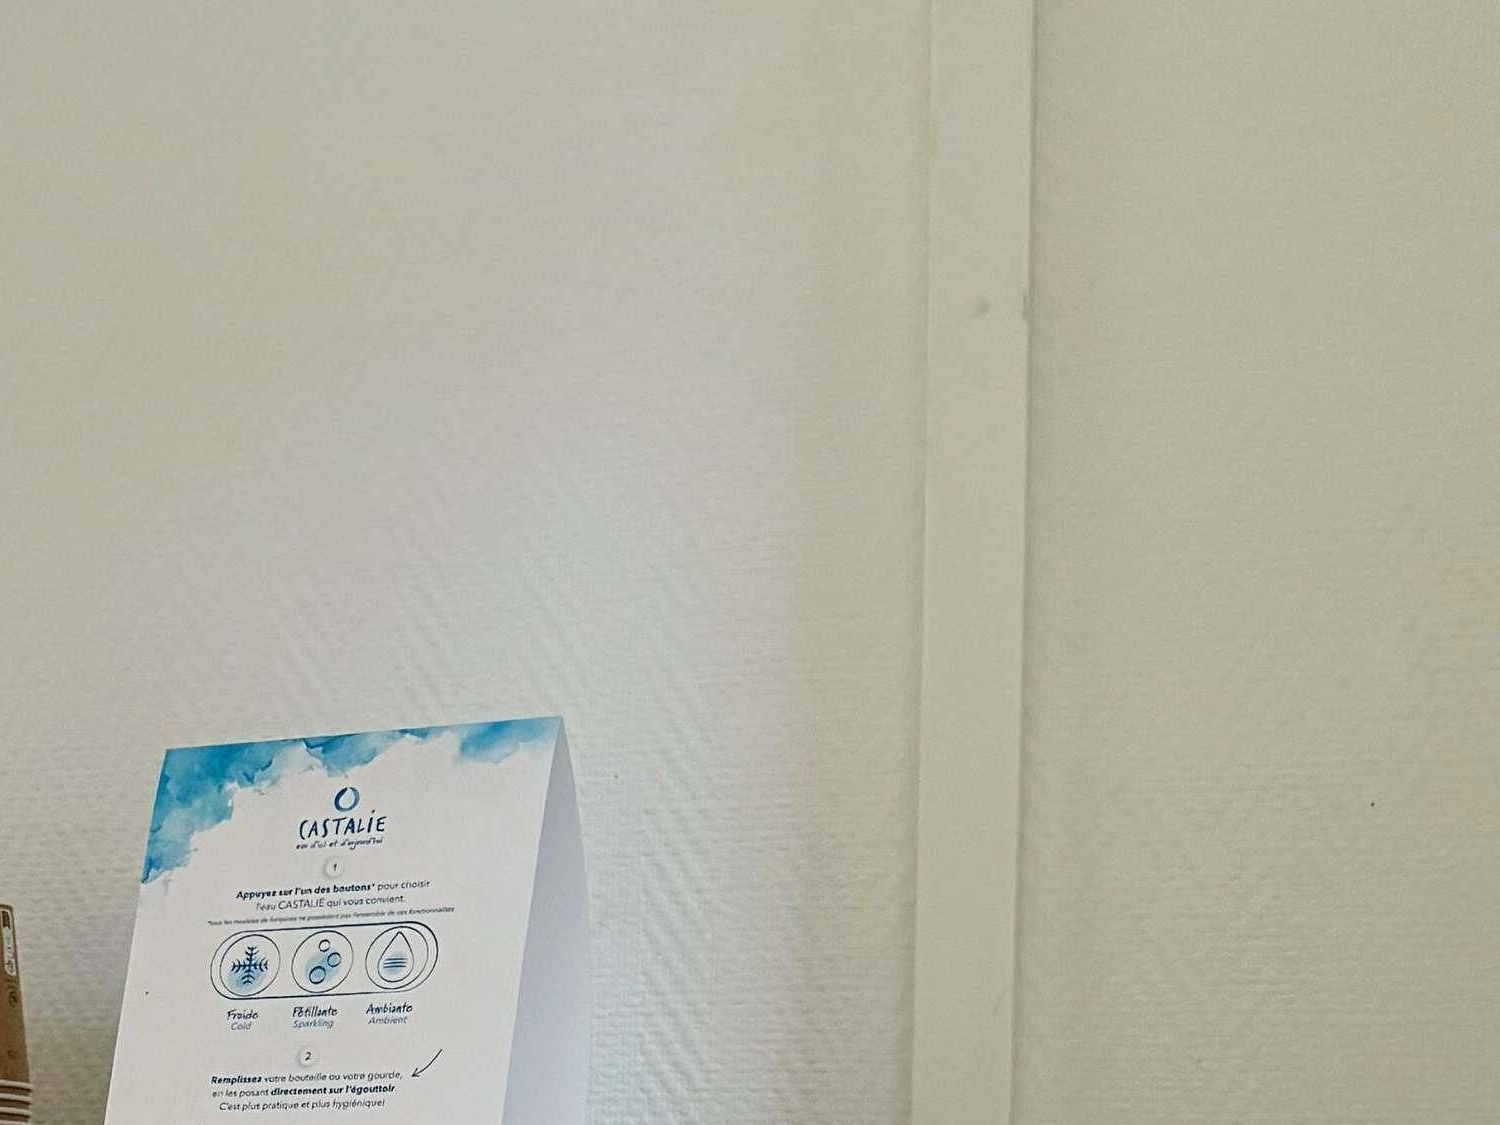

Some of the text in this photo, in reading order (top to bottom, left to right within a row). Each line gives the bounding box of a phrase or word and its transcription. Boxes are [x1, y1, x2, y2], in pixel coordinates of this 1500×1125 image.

[236, 890, 276, 901] Appuyez
[314, 886, 330, 894] des
[377, 882, 398, 891] pour
[401, 880, 431, 889] choisir
[278, 898, 324, 910] CASTALIE
[327, 898, 341, 908] qui
[343, 898, 363, 906] vous
[366, 1002, 413, 1014] Ambiante
[227, 1009, 259, 1020] Froide
[367, 1016, 408, 1024] Ambient
[231, 1021, 251, 1031] Cold
[292, 1020, 334, 1029] Sparkling
[304, 1051, 311, 1061] 2
[211, 1075, 262, 1085] Remplissez
[264, 1075, 286, 1083] votre
[288, 1073, 327, 1082] bouteille
[239, 1089, 269, 1098] posant
[271, 1086, 327, 1096] directement
[242, 1102, 260, 1111] plus
[262, 1101, 299, 1111] pratique
[311, 1100, 330, 1109] plus
